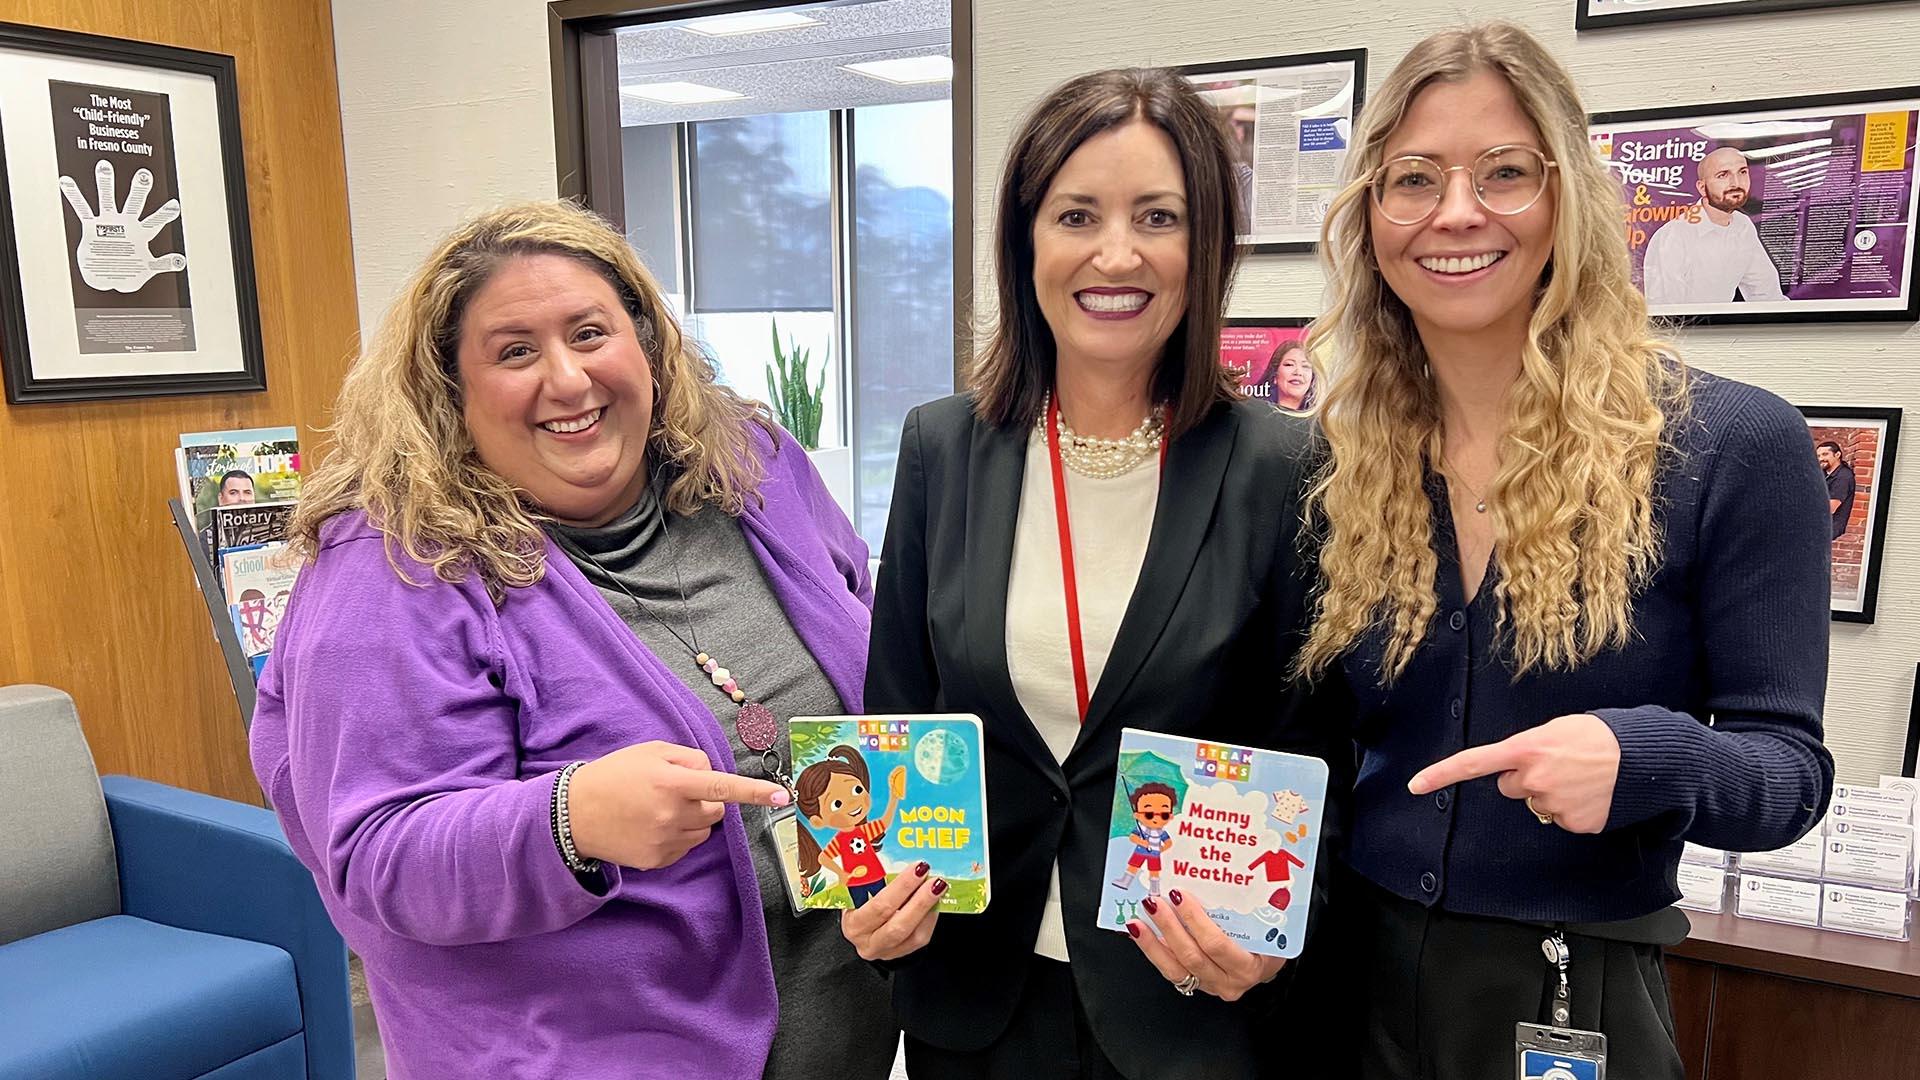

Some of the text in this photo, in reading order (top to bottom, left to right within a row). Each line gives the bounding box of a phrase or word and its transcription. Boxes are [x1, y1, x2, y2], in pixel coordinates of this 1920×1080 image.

[90, 93, 132, 110] The Most
[72, 106, 151, 128] “Child-Friendly”
[88, 123, 140, 139] Businesses
[77, 137, 153, 156] in Fresno County
[1619, 137, 1708, 162] Starting
[1619, 164, 1684, 187] Young
[1633, 185, 1651, 206] &
[223, 512, 273, 526] Rotary
[860, 723, 910, 733] STEAM
[858, 736, 908, 747] WORKS
[1199, 747, 1253, 764] STEAM
[1194, 760, 1248, 777] WORKS
[899, 806, 965, 824] MOON
[1189, 802, 1250, 830] Manny
[897, 827, 970, 849] CHEF
[1178, 821, 1257, 847] Matches
[1199, 845, 1232, 863] the
[1173, 859, 1254, 886] Weather
